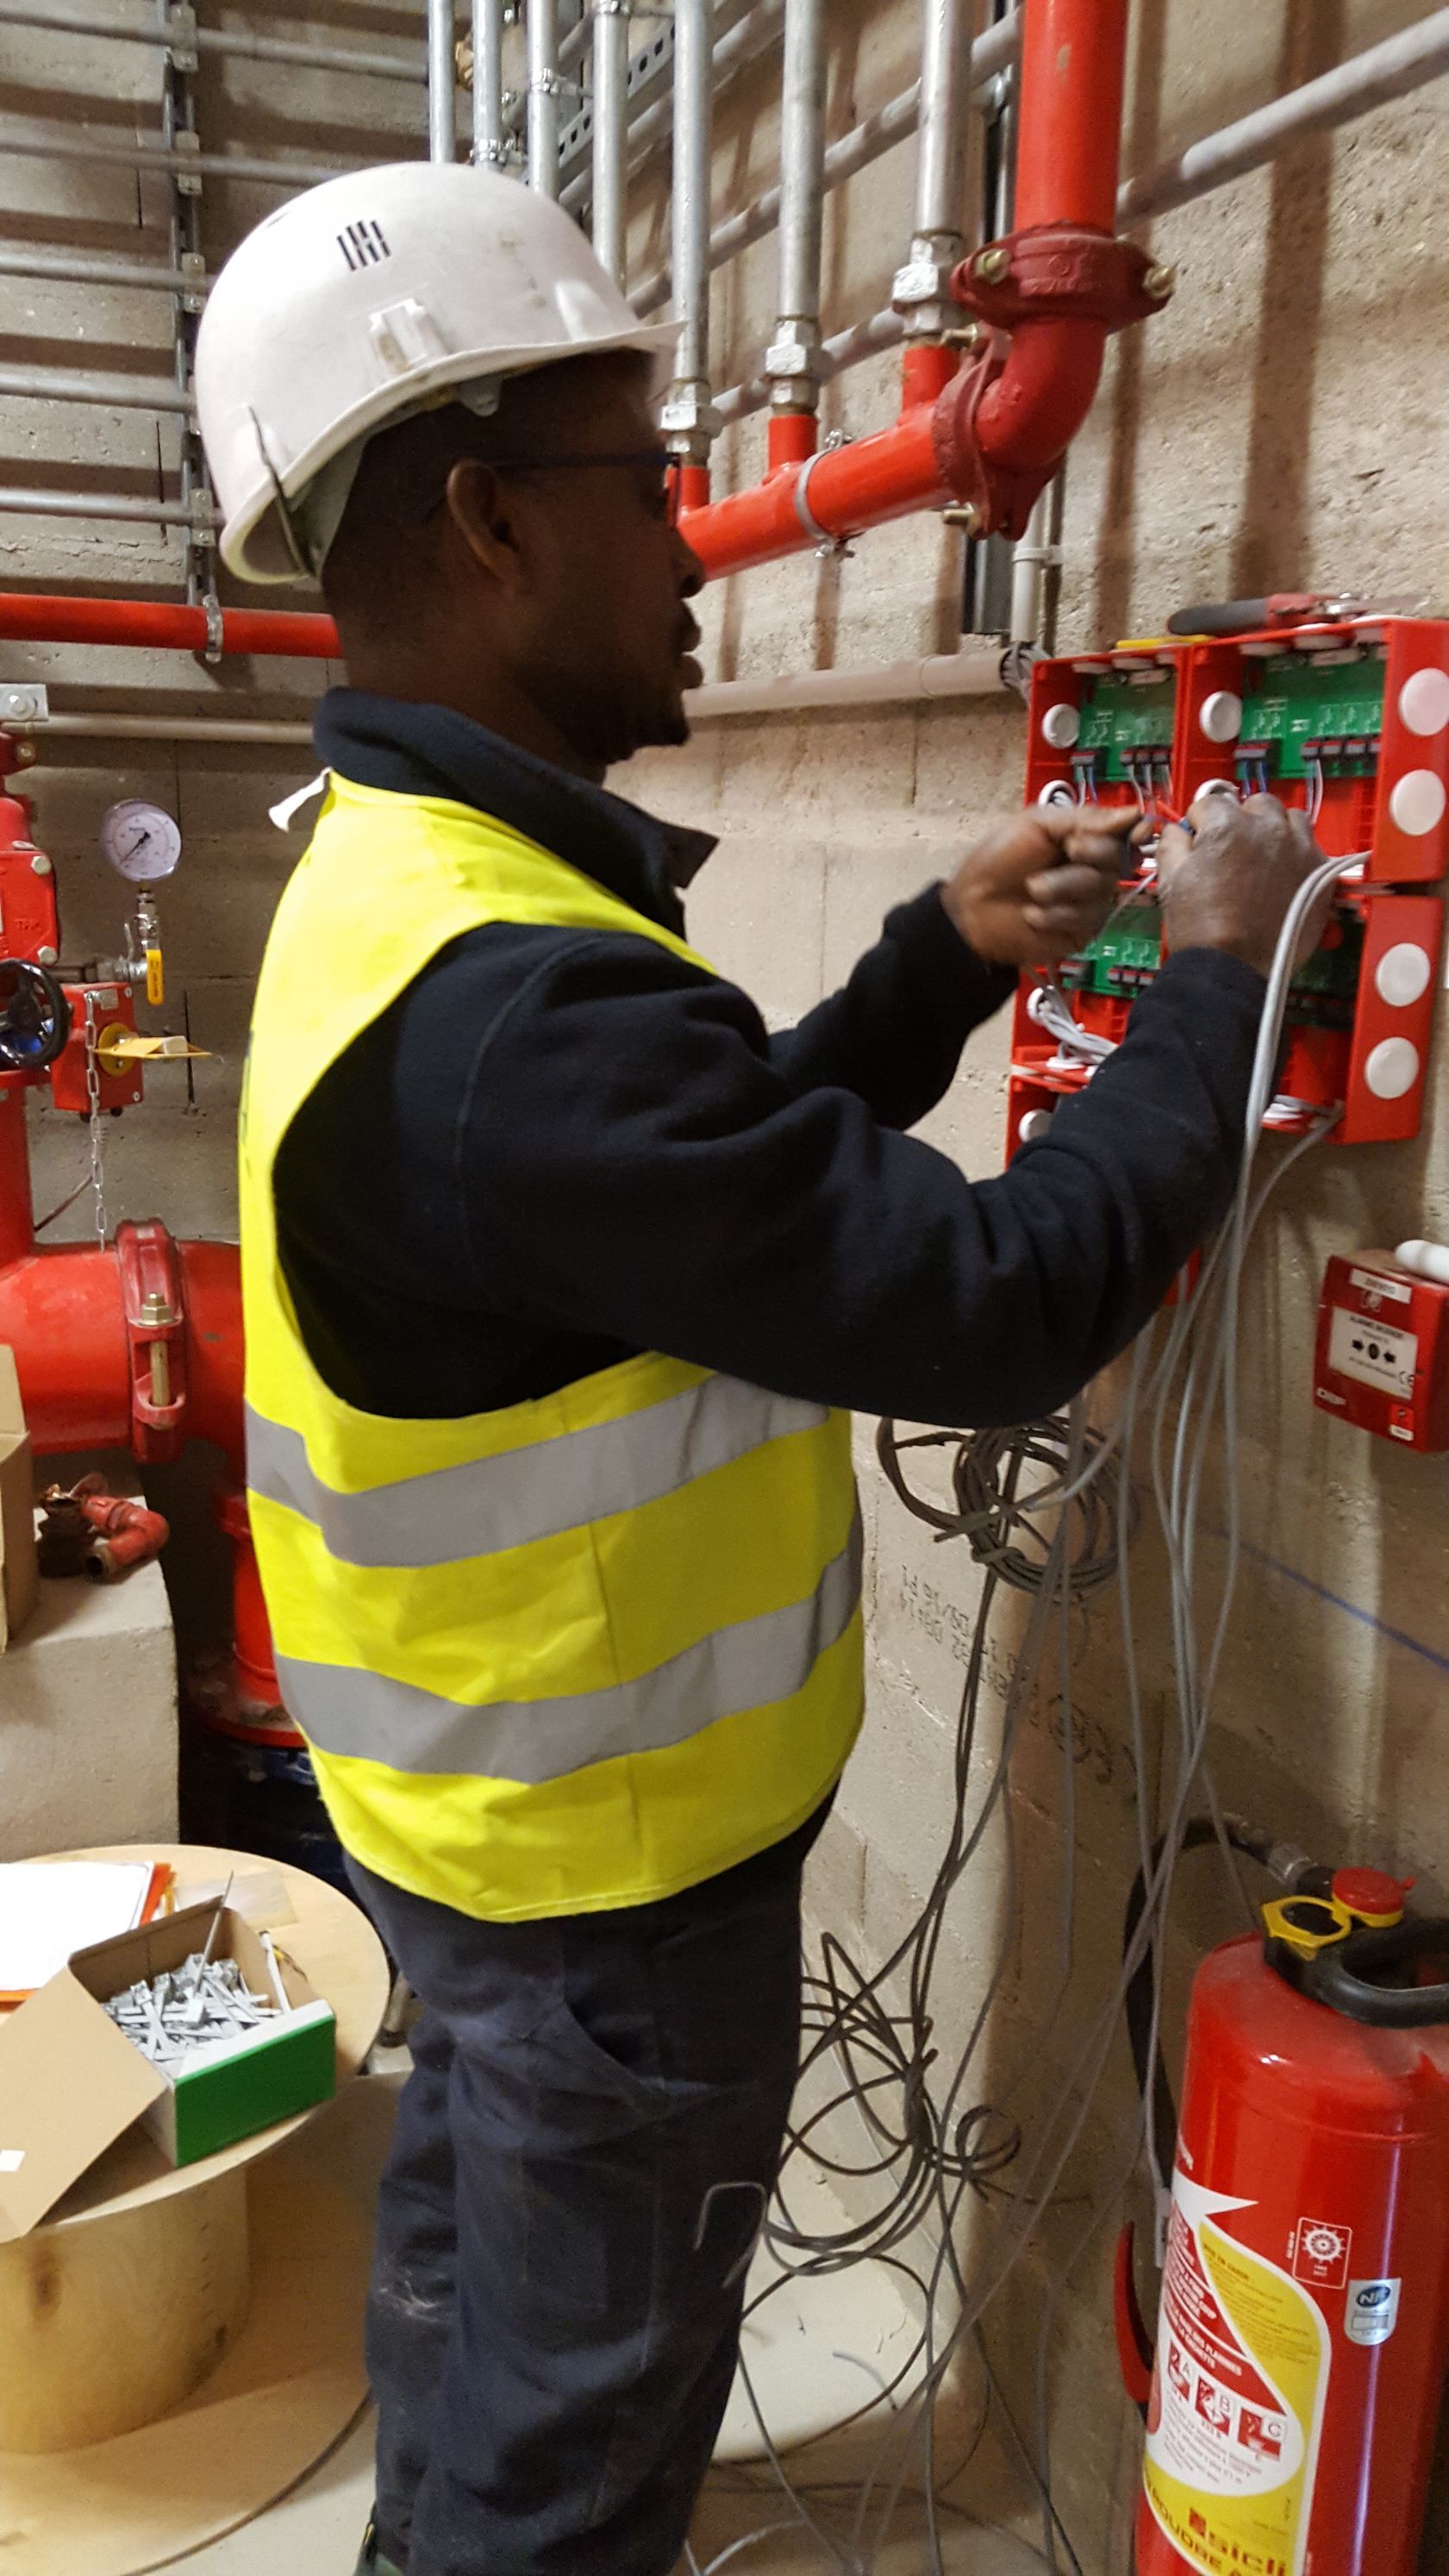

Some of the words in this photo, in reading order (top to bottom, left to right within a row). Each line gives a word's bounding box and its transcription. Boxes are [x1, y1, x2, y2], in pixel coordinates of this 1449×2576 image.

[1182, 2361, 1191, 2377] A
[1219, 2394, 1230, 2413] B
[1268, 2421, 1282, 2438] C
